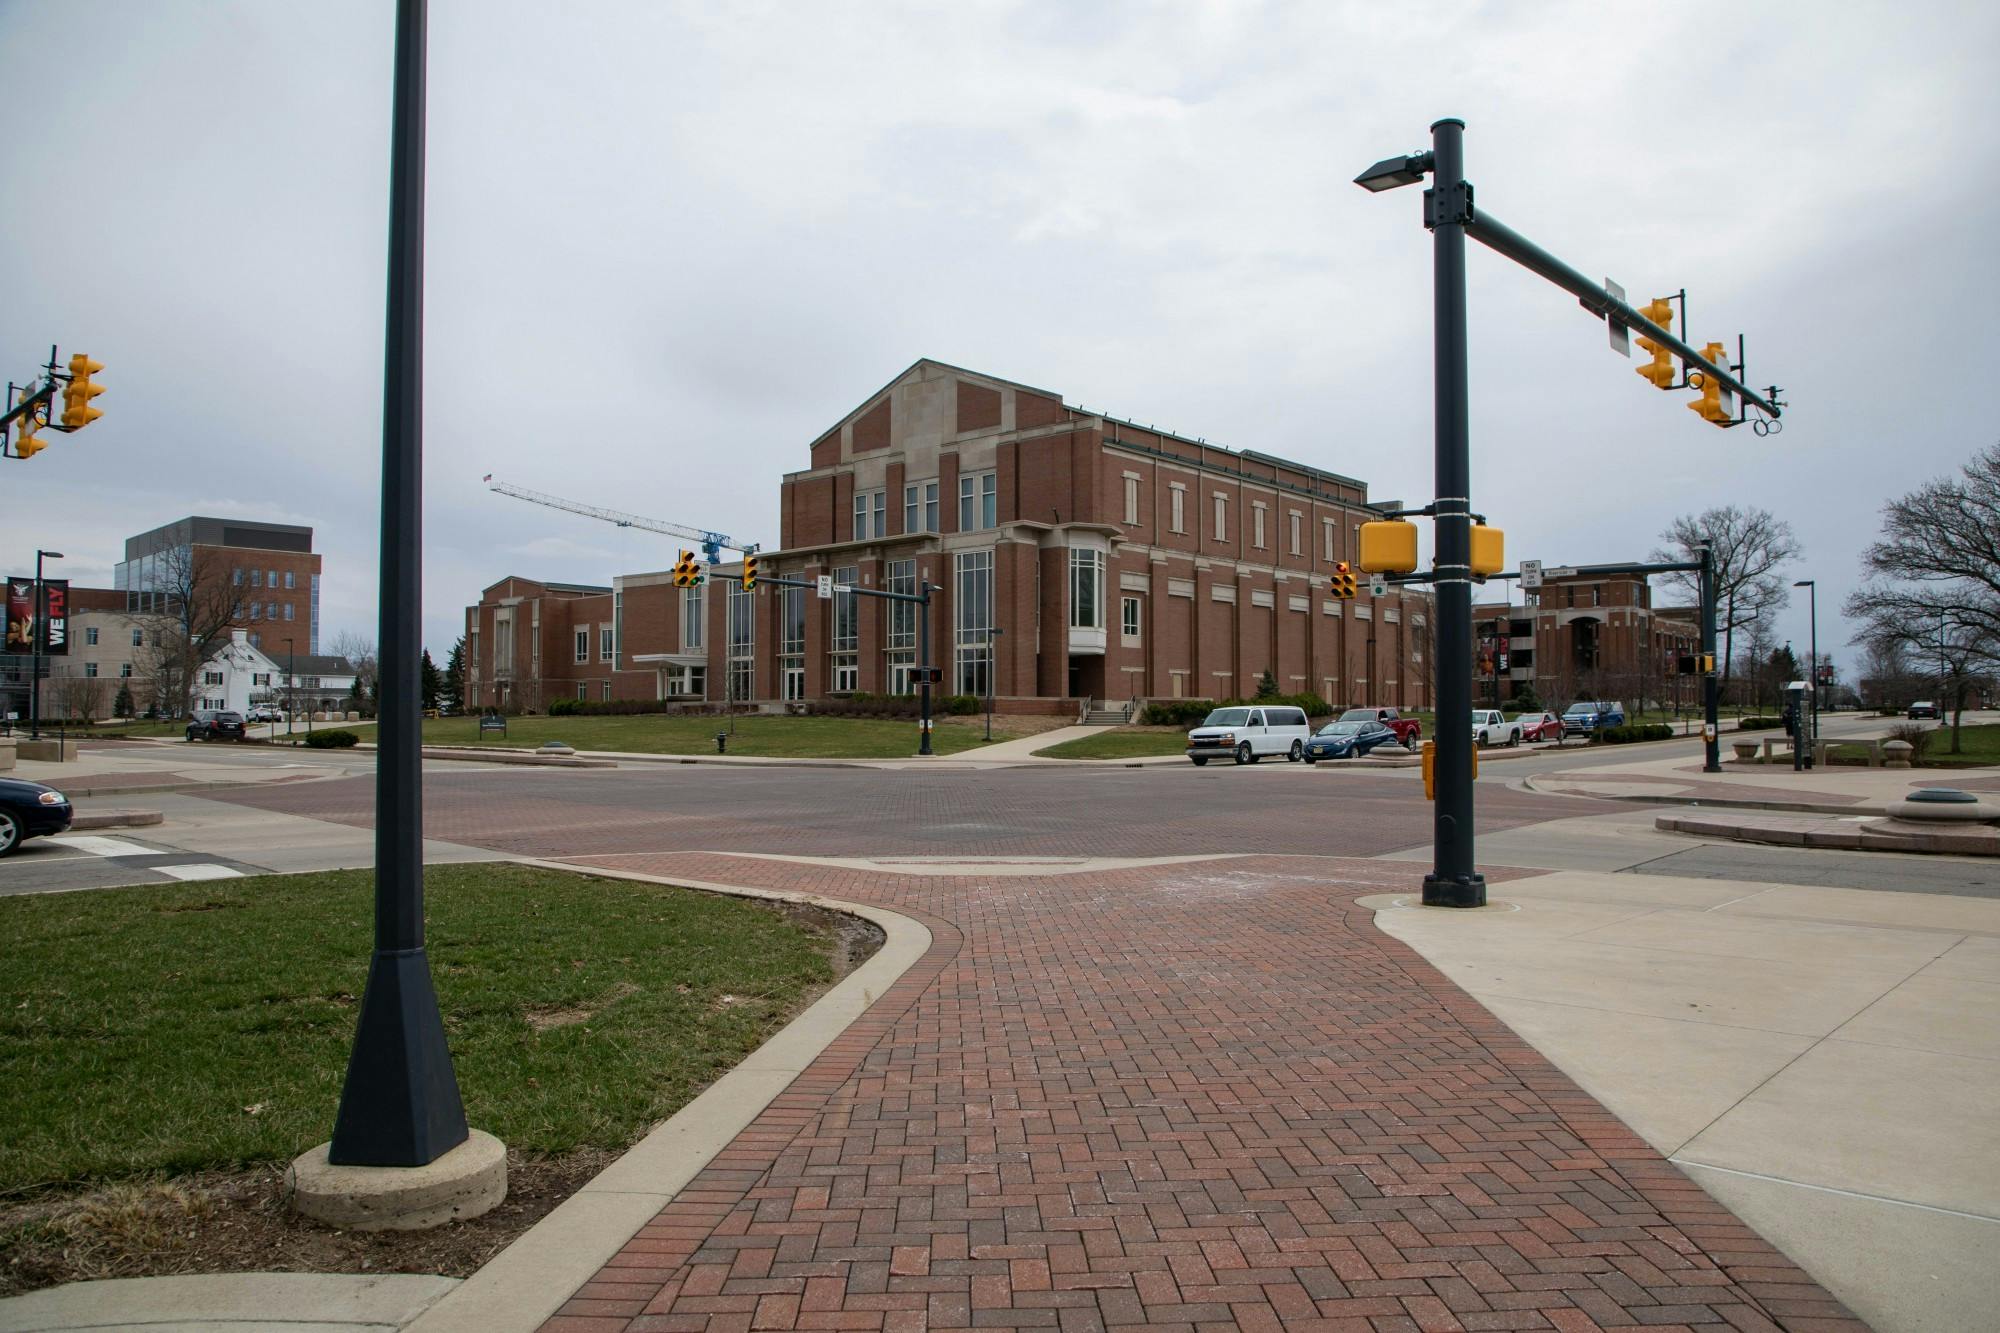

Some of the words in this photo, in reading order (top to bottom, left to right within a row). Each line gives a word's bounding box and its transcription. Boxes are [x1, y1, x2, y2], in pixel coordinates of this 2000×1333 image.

[48, 587, 65, 617] FLY
[49, 618, 65, 646] WE
[1499, 654, 1508, 670] WE
